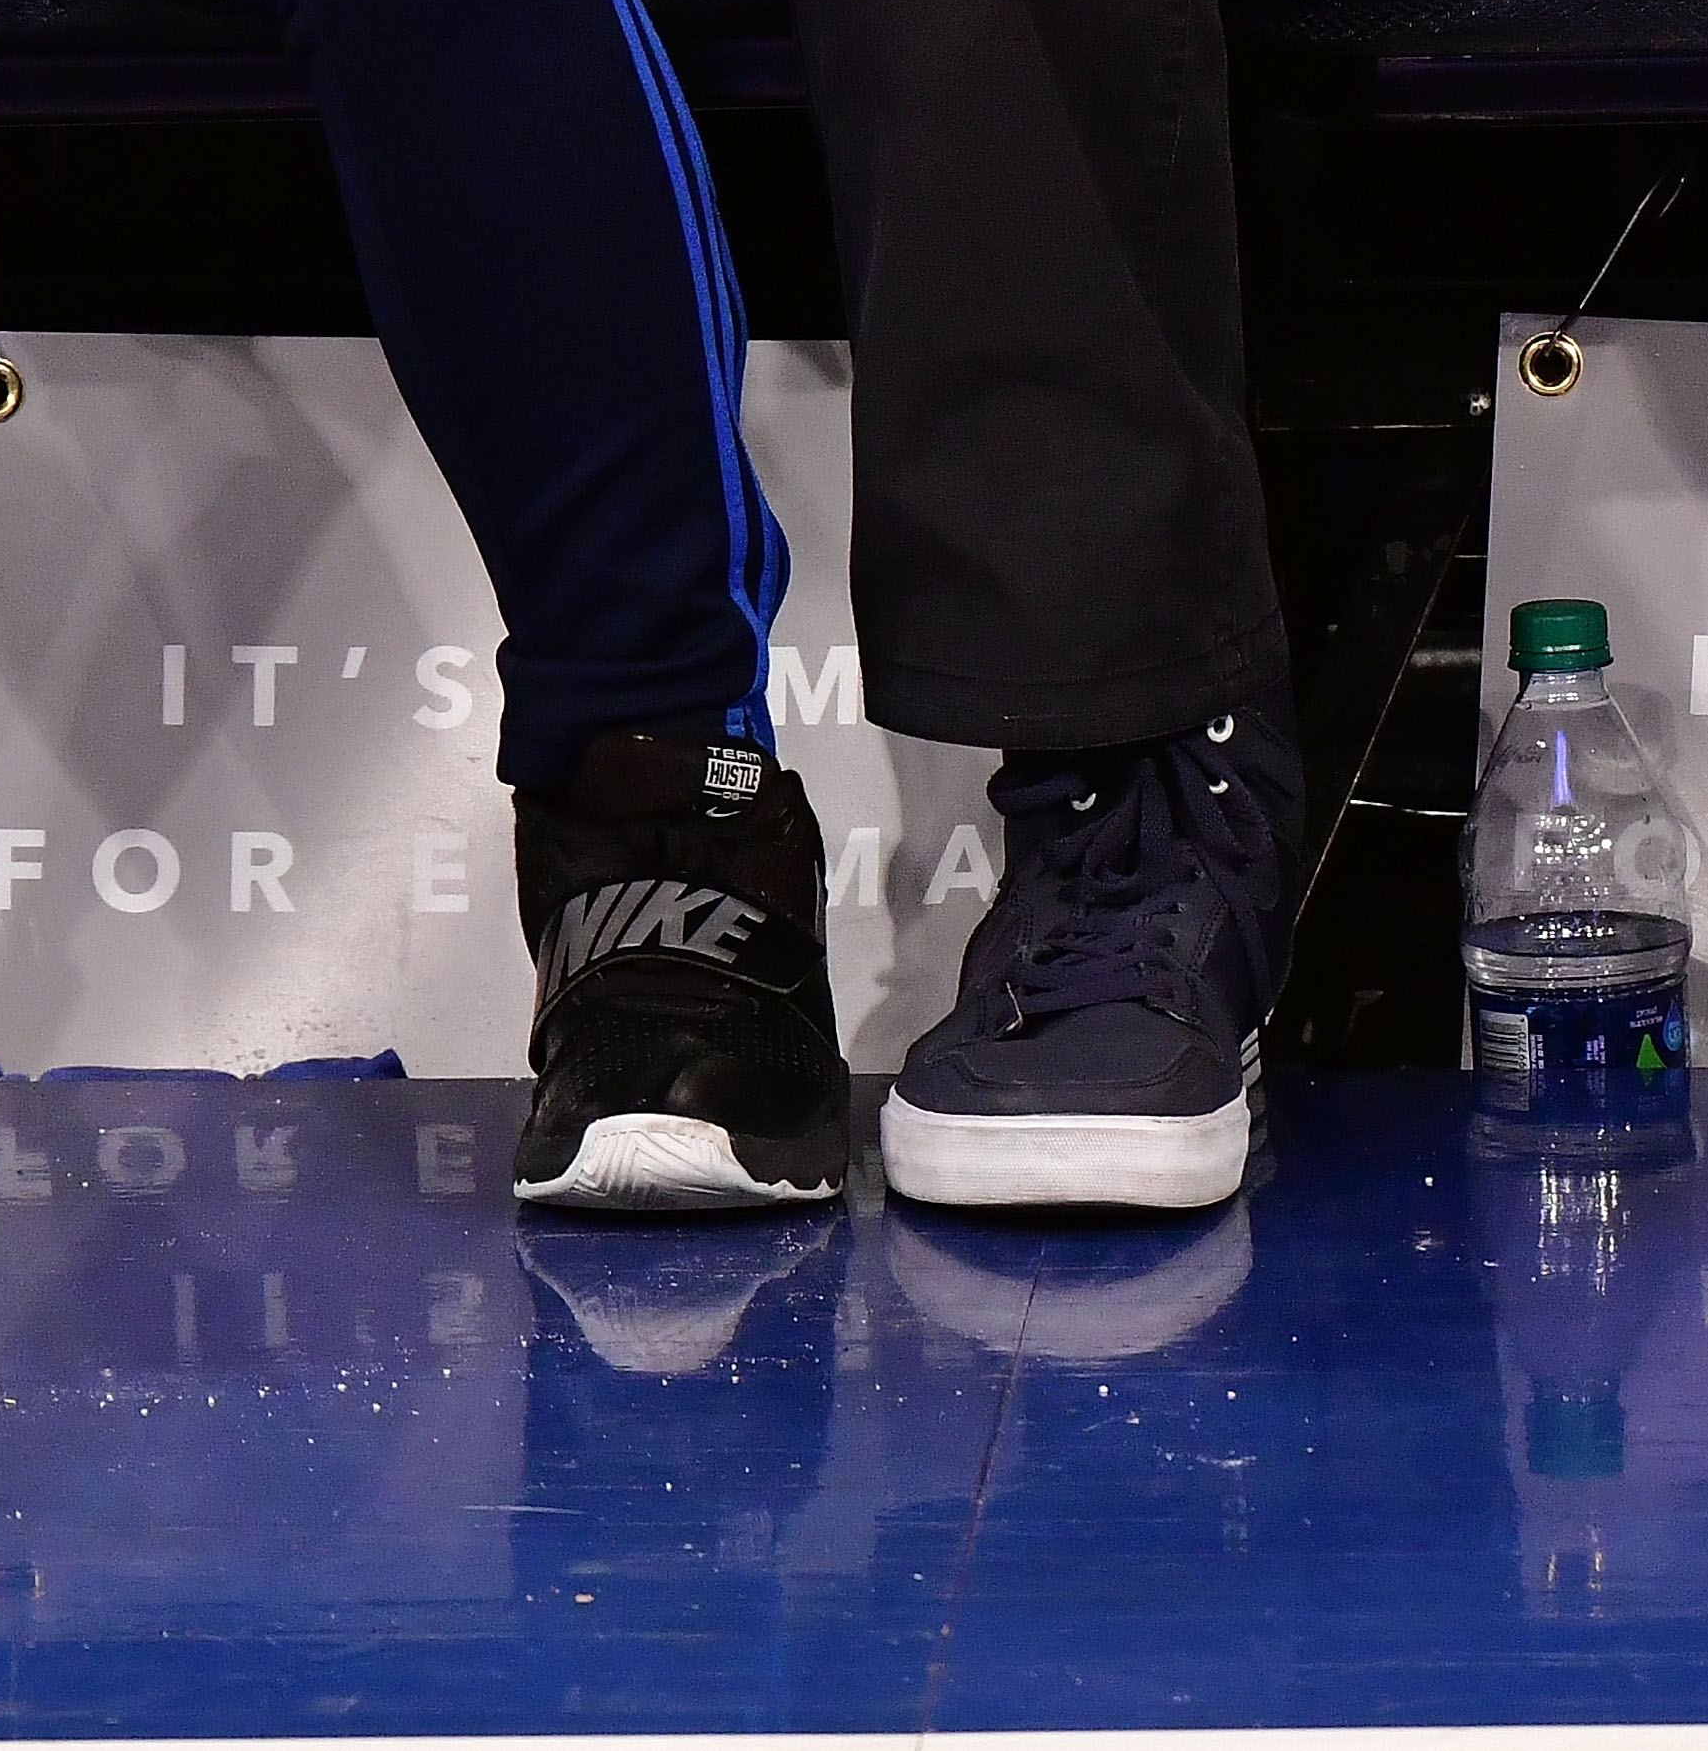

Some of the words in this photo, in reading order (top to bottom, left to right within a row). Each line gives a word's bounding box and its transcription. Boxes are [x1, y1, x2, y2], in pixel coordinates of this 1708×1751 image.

[706, 745, 763, 765] TEAM
[708, 760, 759, 790] HUSTLE
[545, 880, 768, 1003] NIKE
